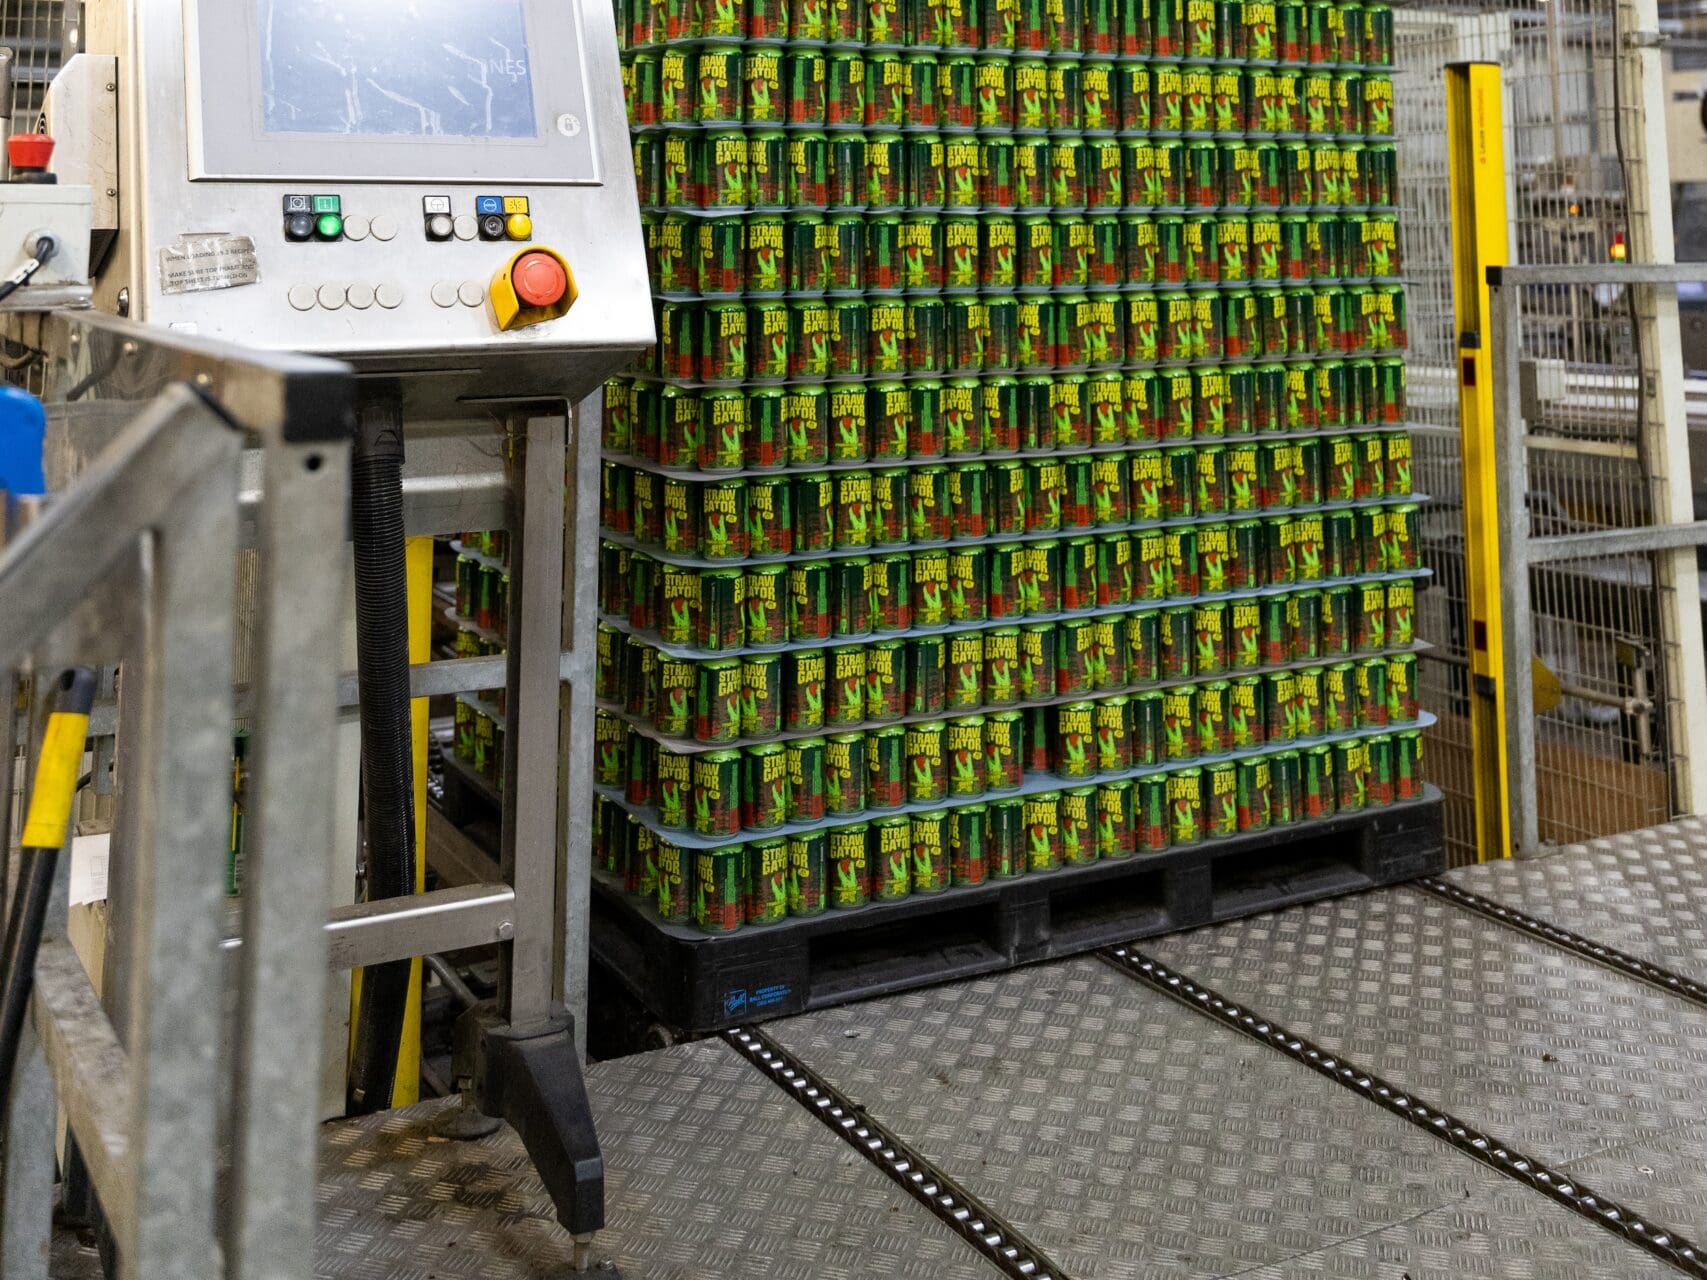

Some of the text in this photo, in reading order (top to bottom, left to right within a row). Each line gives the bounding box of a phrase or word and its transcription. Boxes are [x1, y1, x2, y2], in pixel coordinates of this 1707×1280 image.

[947, 145, 978, 157] STRAW
[947, 156, 978, 168] GATOR
[750, 225, 783, 237] STRAW
[947, 224, 977, 236] STRAW
[750, 236, 783, 248] GATOR
[947, 235, 977, 247] GATOR
[872, 308, 904, 319] STRAW
[872, 319, 904, 331] GATOR
[832, 394, 865, 405] STRAW
[832, 405, 865, 417] GATOR
[704, 489, 735, 500] STRAW
[704, 500, 735, 513] GATOR
[916, 559, 947, 571] STRAW
[986, 636, 1017, 648] STRAW
[986, 647, 1017, 660] GATOR
[1059, 711, 1091, 723] STRAW
[949, 727, 981, 738] STRAW
[1059, 722, 1091, 734] GATOR
[907, 732, 939, 744] STRAW
[949, 737, 981, 750] GATOR
[907, 743, 939, 757] GATOR
[831, 834, 864, 846] STRAW
[831, 845, 864, 859] GATOR
